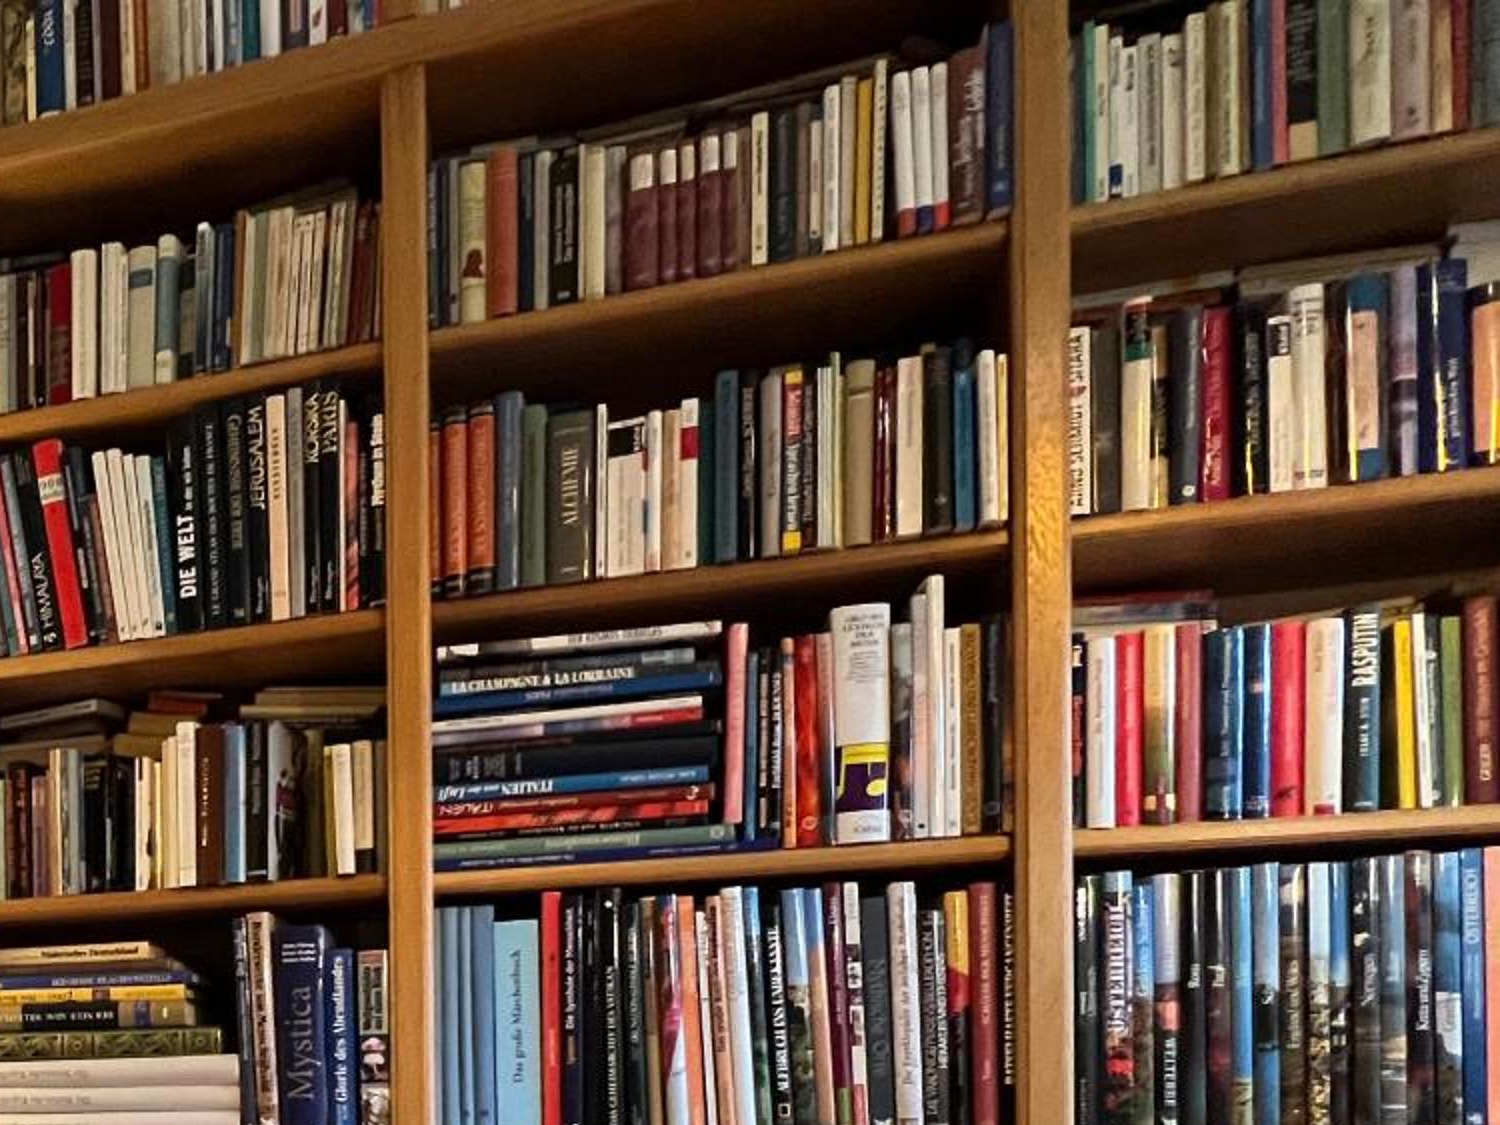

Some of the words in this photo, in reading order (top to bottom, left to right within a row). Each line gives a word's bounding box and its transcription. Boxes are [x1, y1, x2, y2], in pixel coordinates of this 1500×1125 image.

[304, 392, 320, 464] KORSIKA
[321, 390, 338, 453] PARIS
[247, 405, 266, 510] JERUSALEM
[176, 515, 196, 564] WELT
[30, 551, 51, 628] HIMALAYA
[179, 568, 198, 599] DIE
[1351, 613, 1378, 686] RASPUTIN
[501, 780, 554, 796] ITALIEN
[330, 957, 347, 1034] Abendlandes
[284, 985, 323, 1100] Mystica
[331, 1037, 347, 1062] des
[512, 1028, 526, 1059] große
[331, 1063, 348, 1102] Glorie
[513, 1061, 524, 1083] Das
